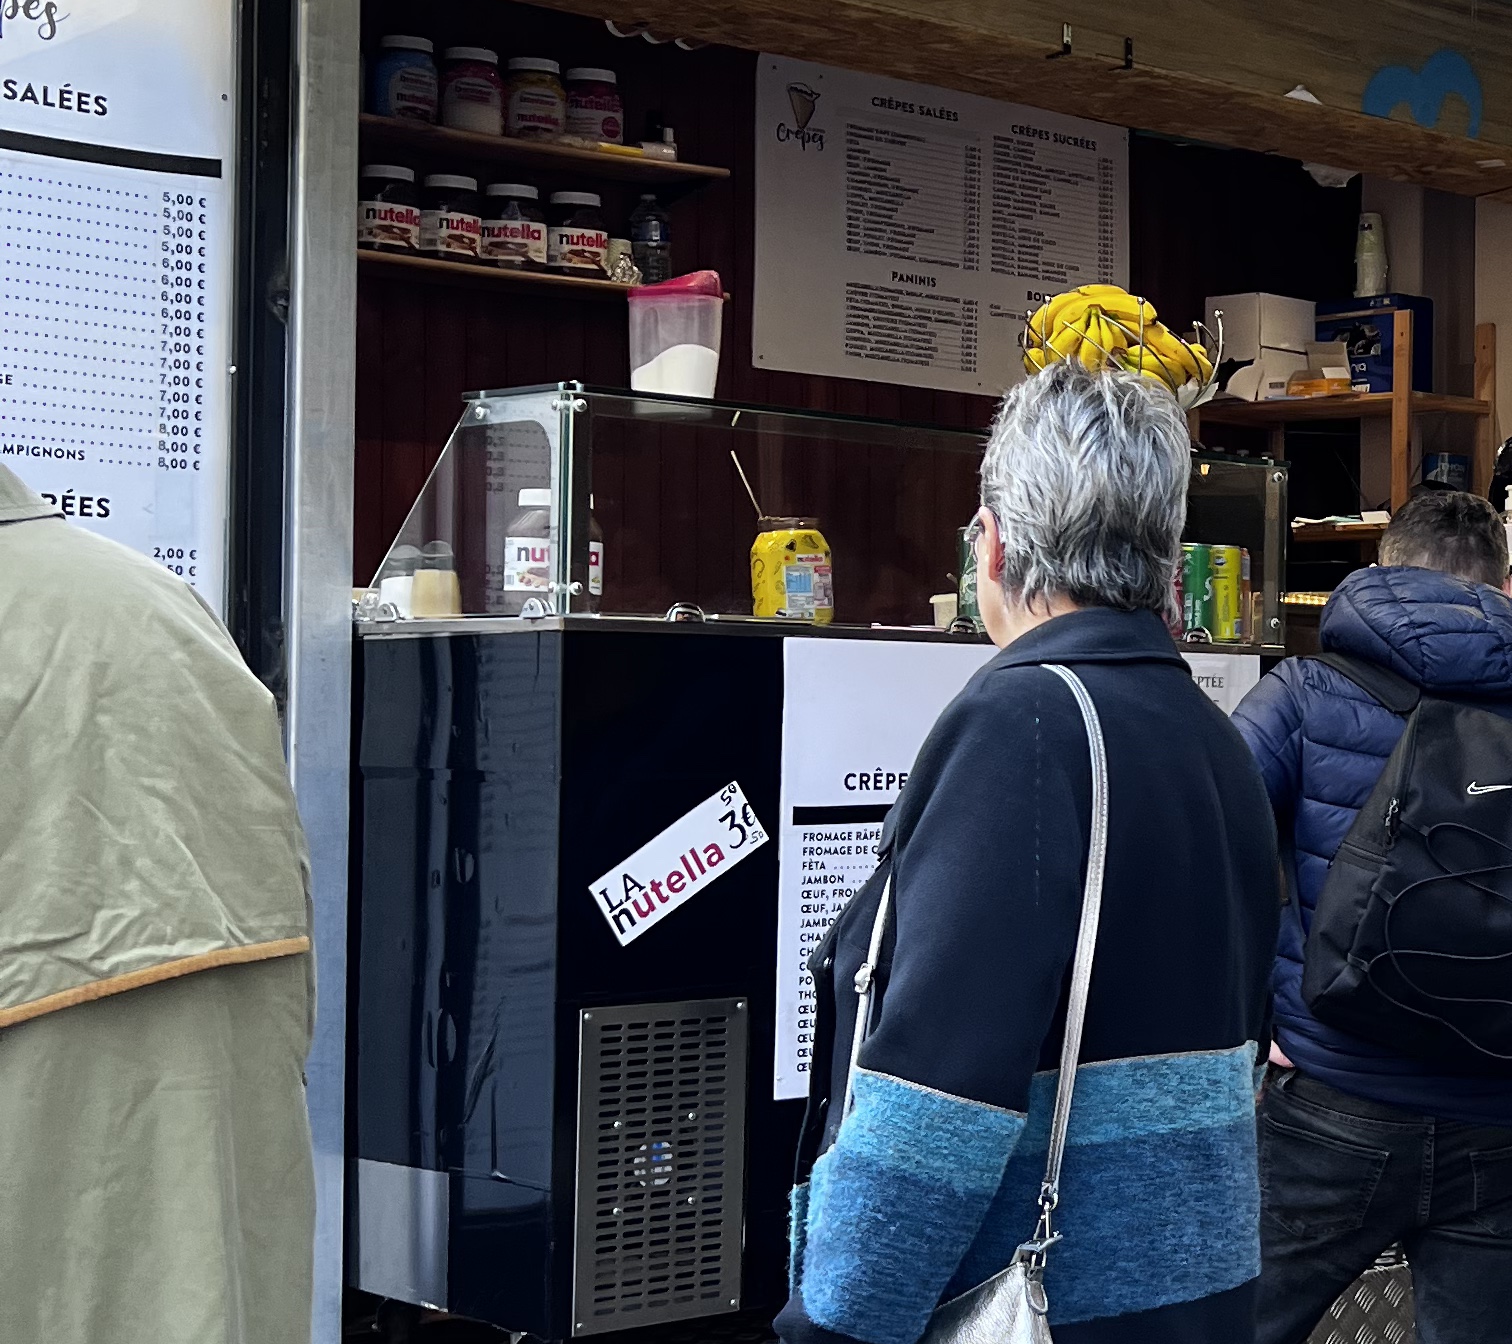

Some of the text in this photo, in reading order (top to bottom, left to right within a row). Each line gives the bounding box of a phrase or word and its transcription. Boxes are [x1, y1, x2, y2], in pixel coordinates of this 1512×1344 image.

[3, 79, 108, 116] SALÉES
[872, 96, 958, 122] CRÊPES SALÉES
[162, 192, 206, 208] 5,00 €
[163, 208, 206, 224] 5,00 €
[163, 225, 206, 240] 5,00 €
[439, 217, 481, 235] nutell
[481, 223, 541, 241] nutella
[162, 241, 206, 257] 5,00 €
[162, 258, 205, 273] 6,00 €
[161, 275, 205, 289] 6,00 €
[161, 291, 204, 306] 6,00 €
[161, 308, 204, 322] 6,00 €
[161, 324, 204, 339] 7,00 €
[160, 341, 203, 355] 7,00 €
[160, 358, 203, 371] 7,00 €
[160, 374, 203, 388] 7,00 €
[160, 390, 203, 405] 7,00 €
[159, 407, 202, 421] 7,00 €
[159, 423, 202, 438] 8,00 €
[158, 440, 201, 454] 8,00 €
[0, 443, 200, 471] MPIGNONS 8,00 €
[154, 547, 197, 560] 2,00 €
[803, 831, 853, 842] FROMAGE
[802, 846, 853, 857] FROMAGE
[855, 846, 869, 855] DE
[801, 874, 845, 885] JAMBON
[599, 873, 646, 913] LA
[611, 843, 725, 935] nutella
